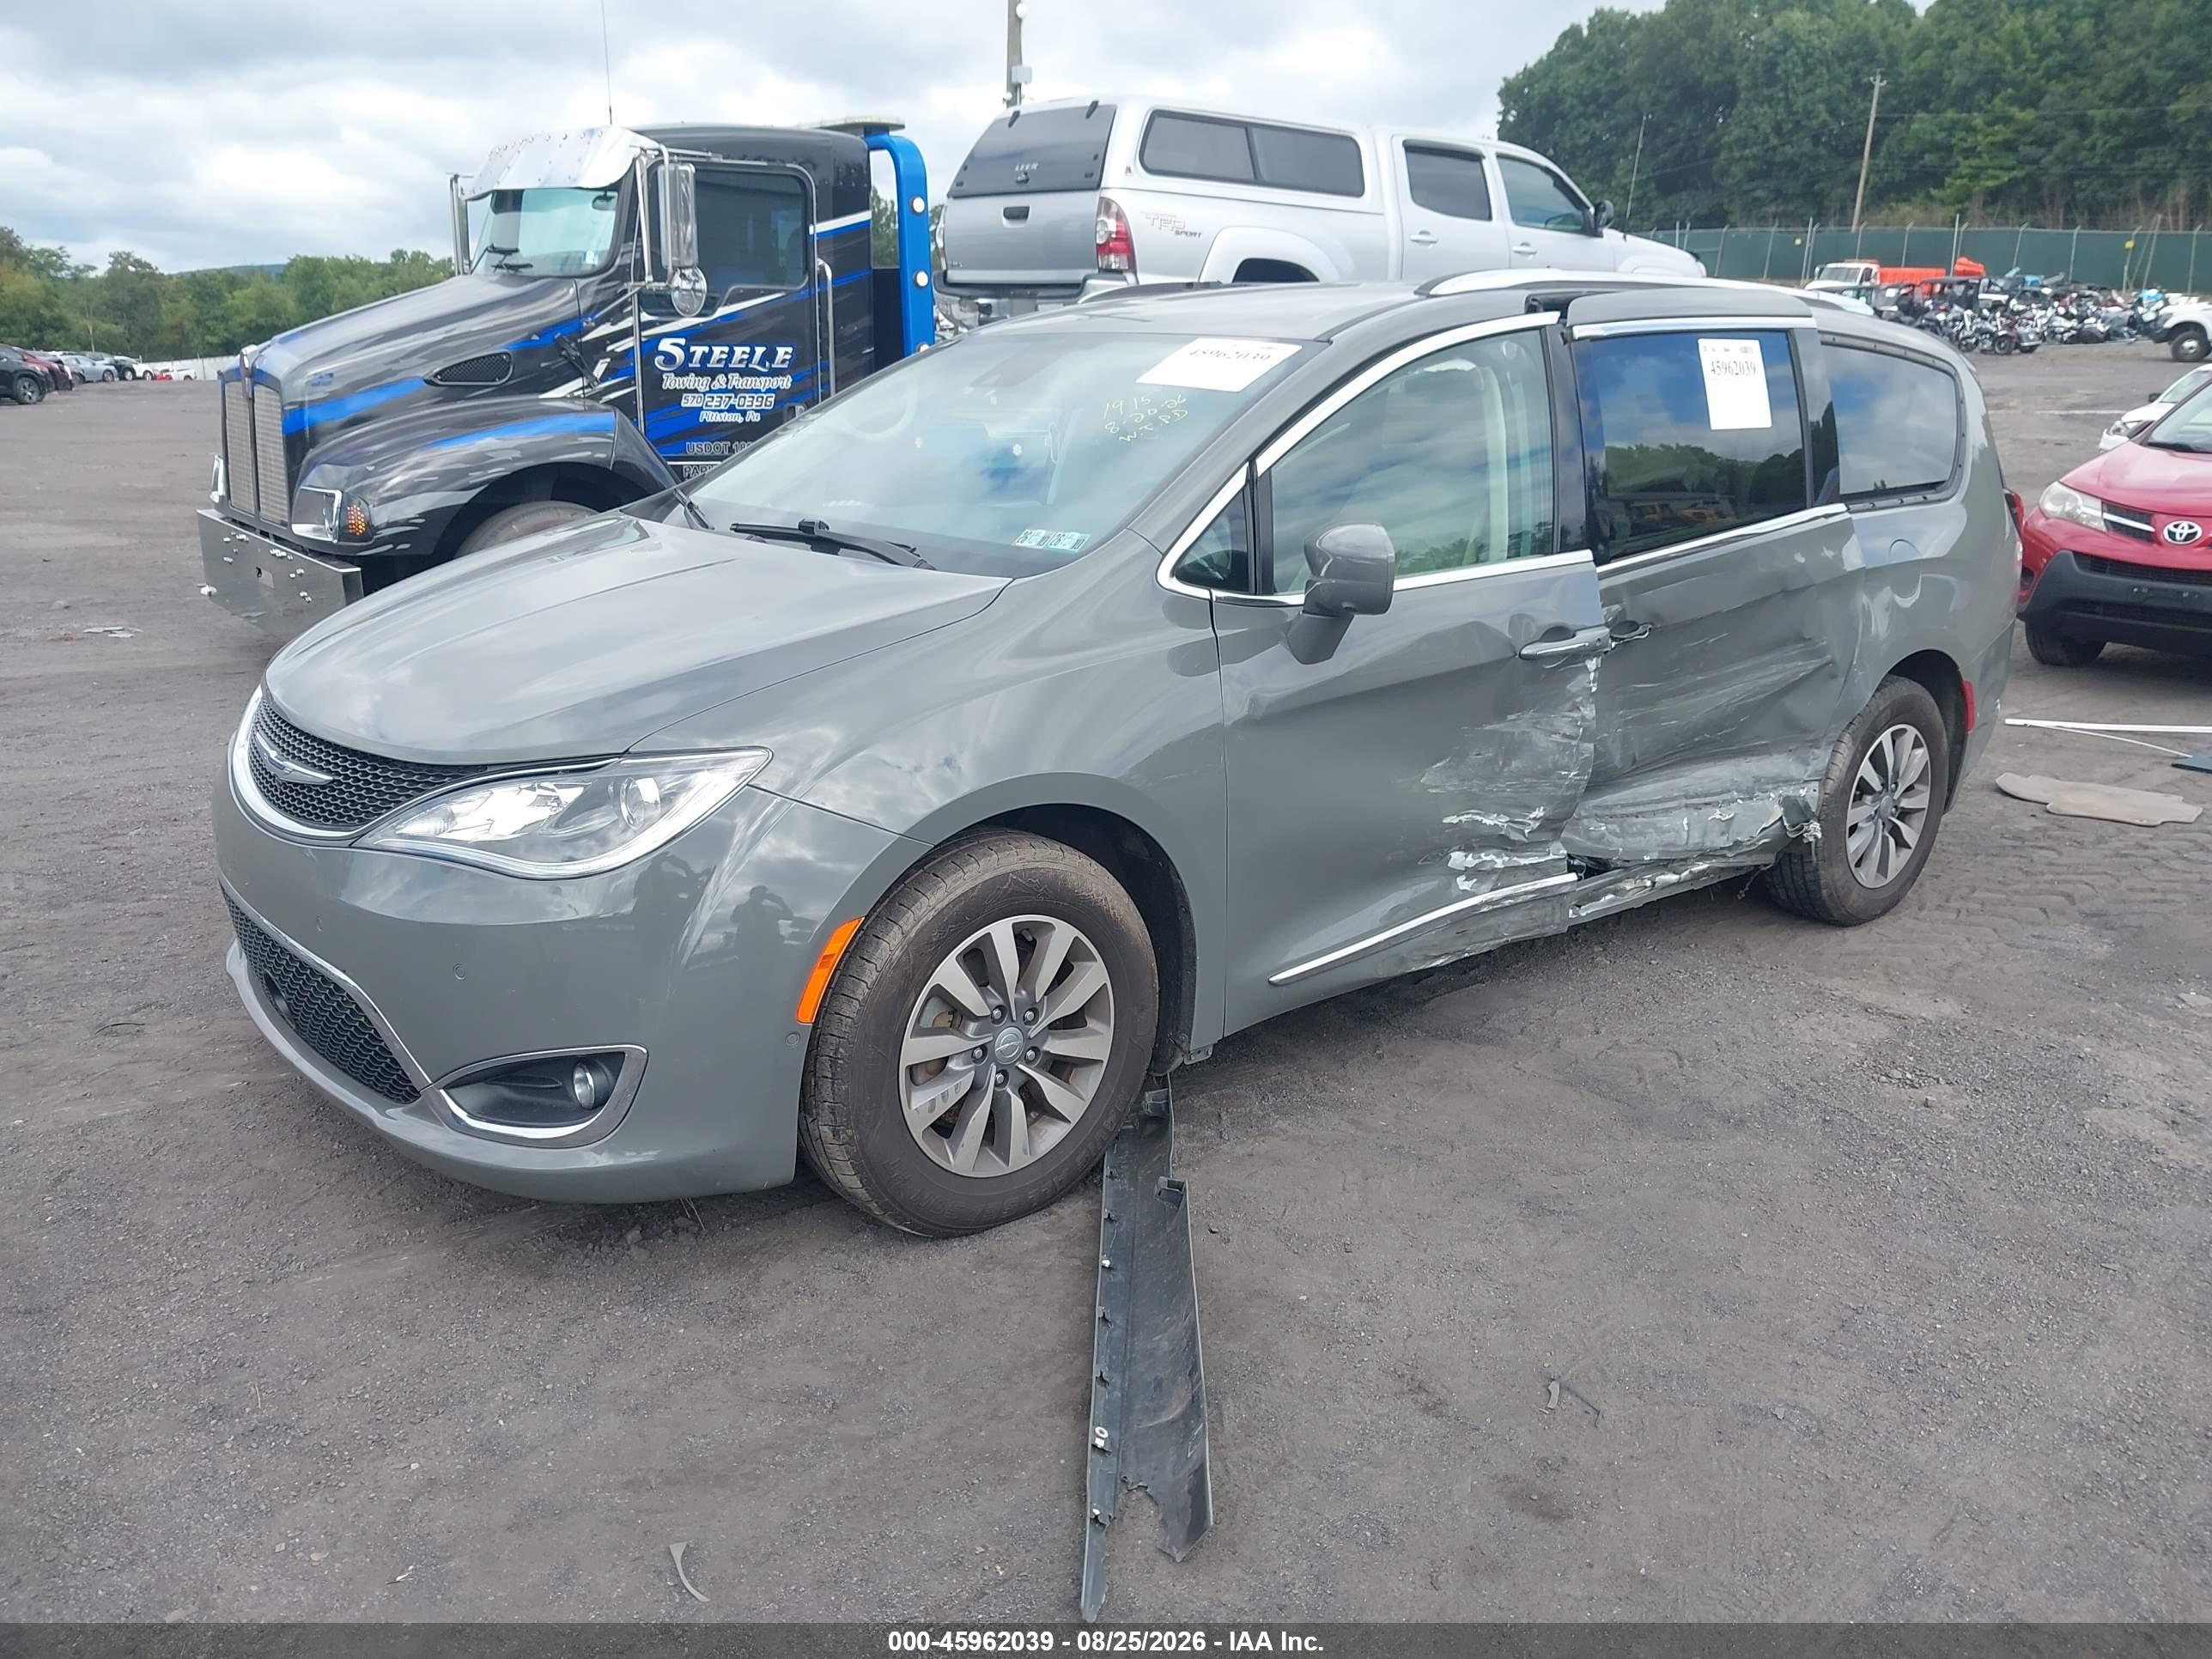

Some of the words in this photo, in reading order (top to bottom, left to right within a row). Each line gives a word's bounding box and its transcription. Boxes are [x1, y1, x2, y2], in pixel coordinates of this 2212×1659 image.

[654, 337, 793, 372] STEELE
[1711, 360, 1756, 376] 45962039
[662, 372, 711, 392] Towing
[712, 373, 727, 390] &
[727, 372, 793, 392] Transport
[681, 393, 704, 407] 570
[703, 393, 775, 410] 237-0396
[699, 410, 744, 423] Pittston,
[745, 410, 761, 422] Pa
[686, 441, 731, 454] USDOT
